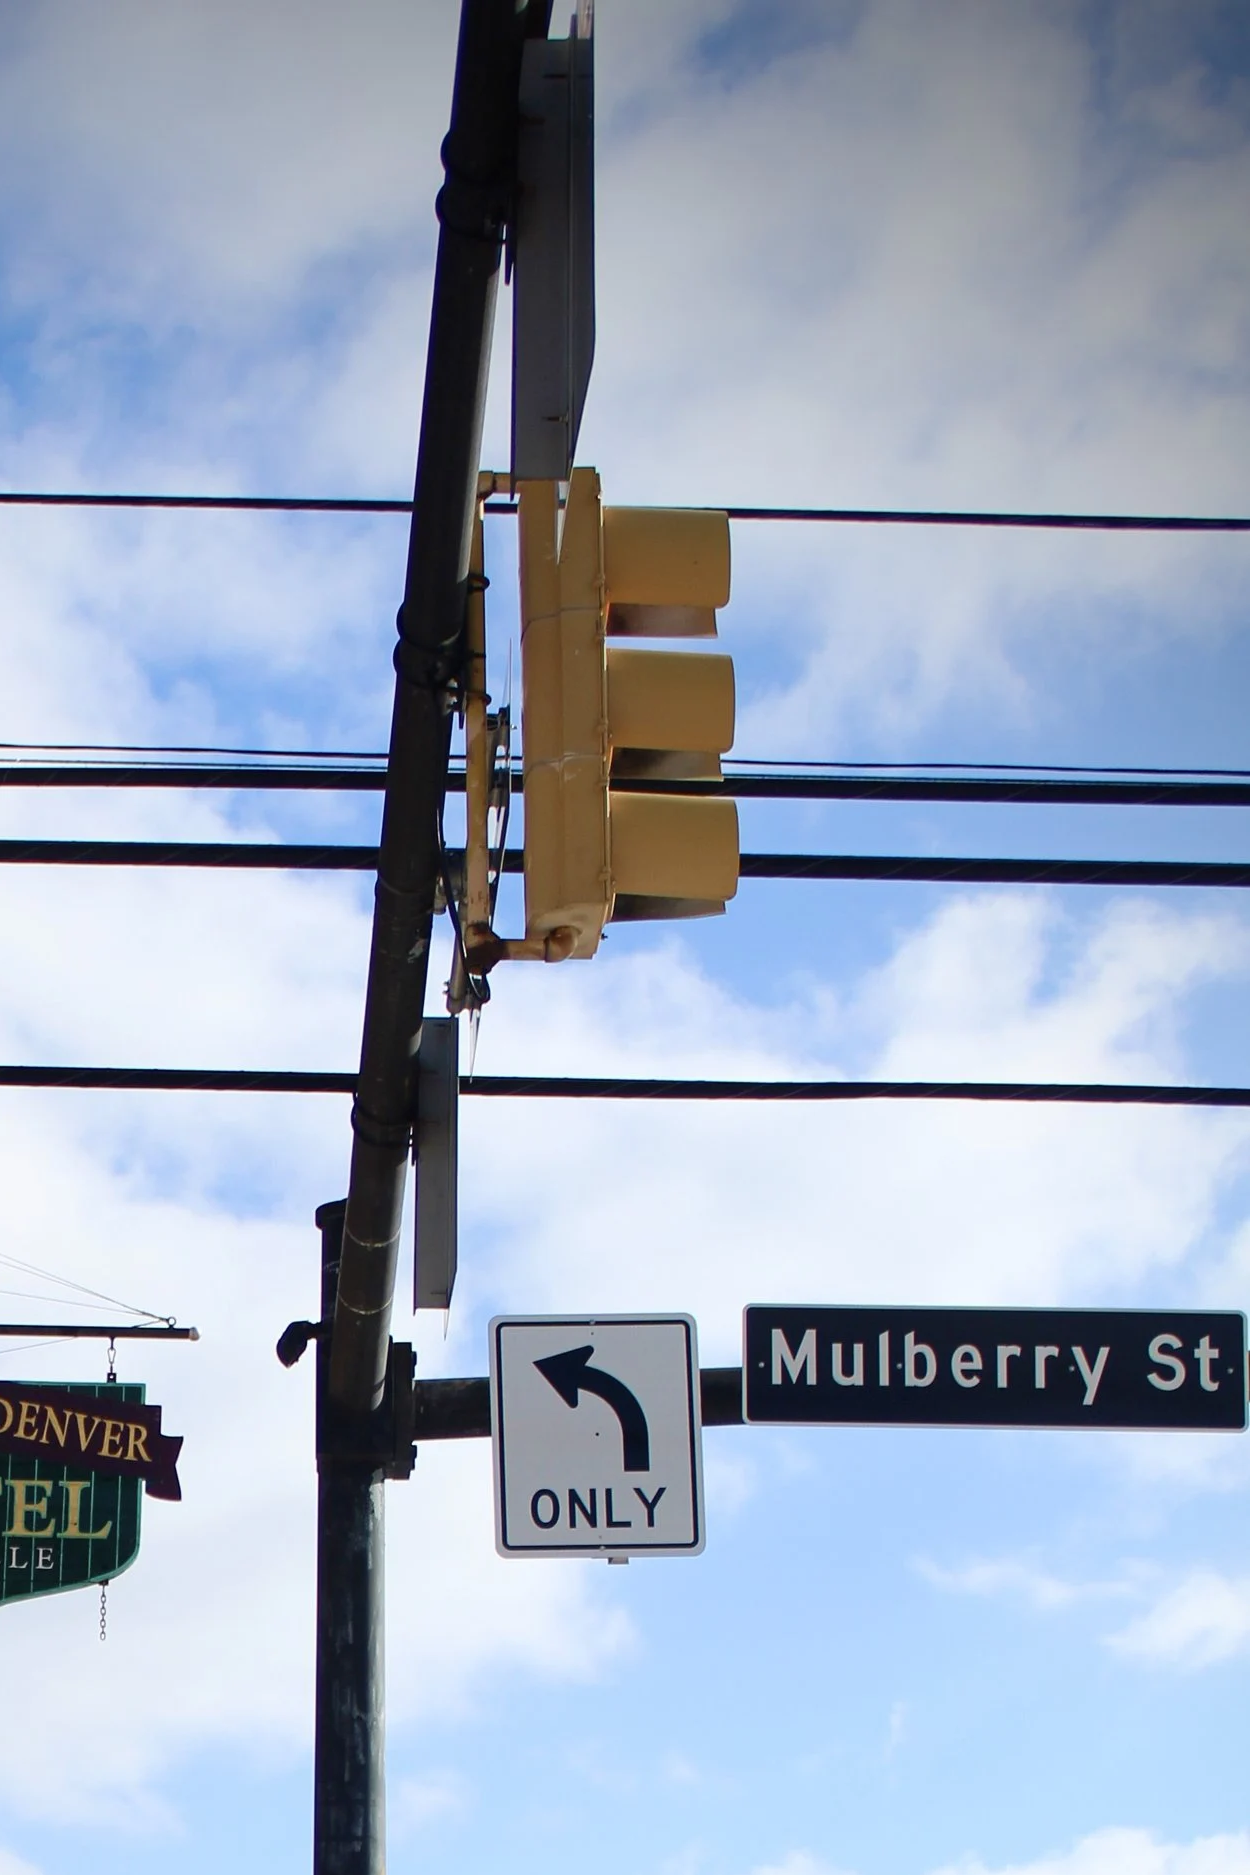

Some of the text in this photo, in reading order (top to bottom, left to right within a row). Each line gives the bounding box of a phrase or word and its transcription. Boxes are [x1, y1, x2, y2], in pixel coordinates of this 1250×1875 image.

[769, 1328, 1221, 1406] Mulberry St
[530, 1487, 667, 1530] ONLY
